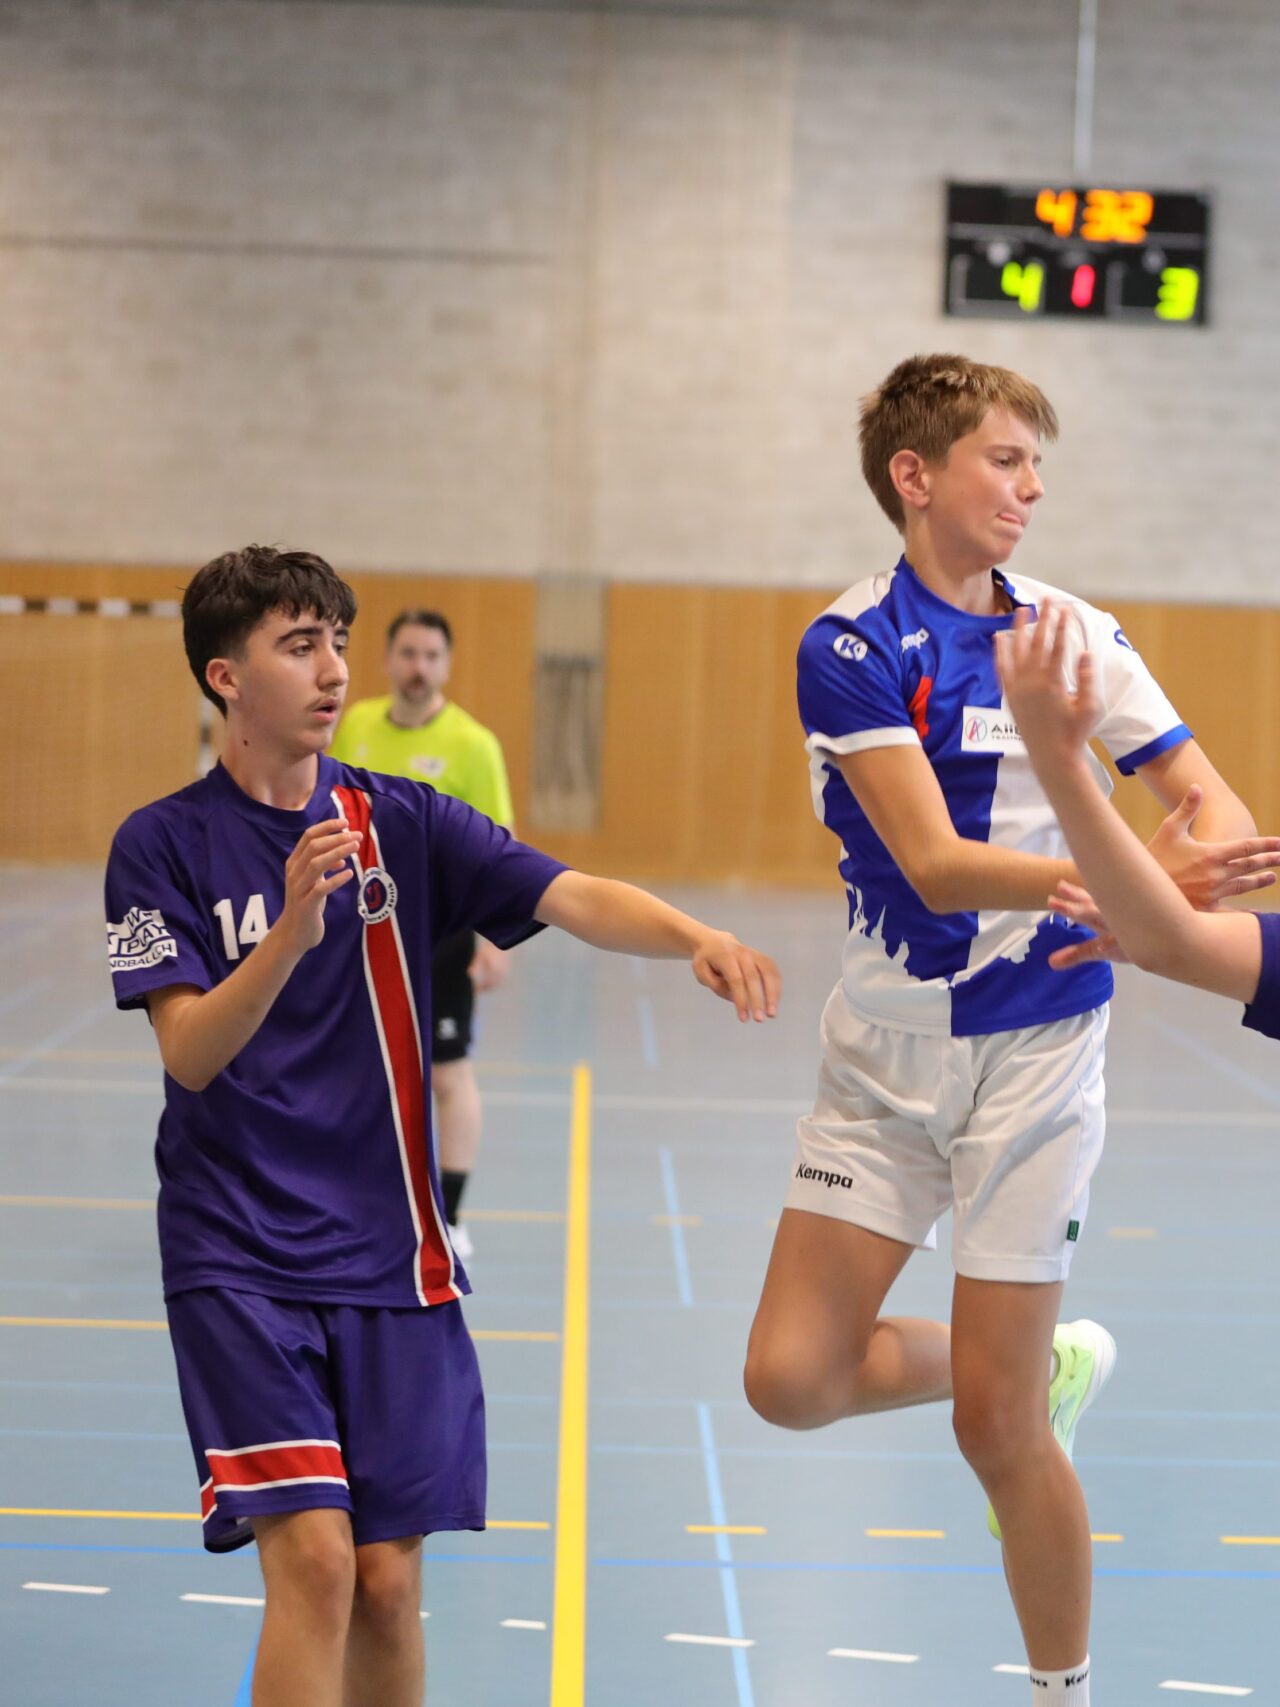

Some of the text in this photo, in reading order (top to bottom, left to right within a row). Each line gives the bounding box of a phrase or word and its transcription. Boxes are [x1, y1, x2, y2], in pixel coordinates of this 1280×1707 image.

[1001, 262, 1044, 312] 4
[1071, 264, 1096, 308] 1
[1155, 267, 1198, 321] 3
[213, 894, 271, 960] 14
[795, 1163, 854, 1189] Kempa
